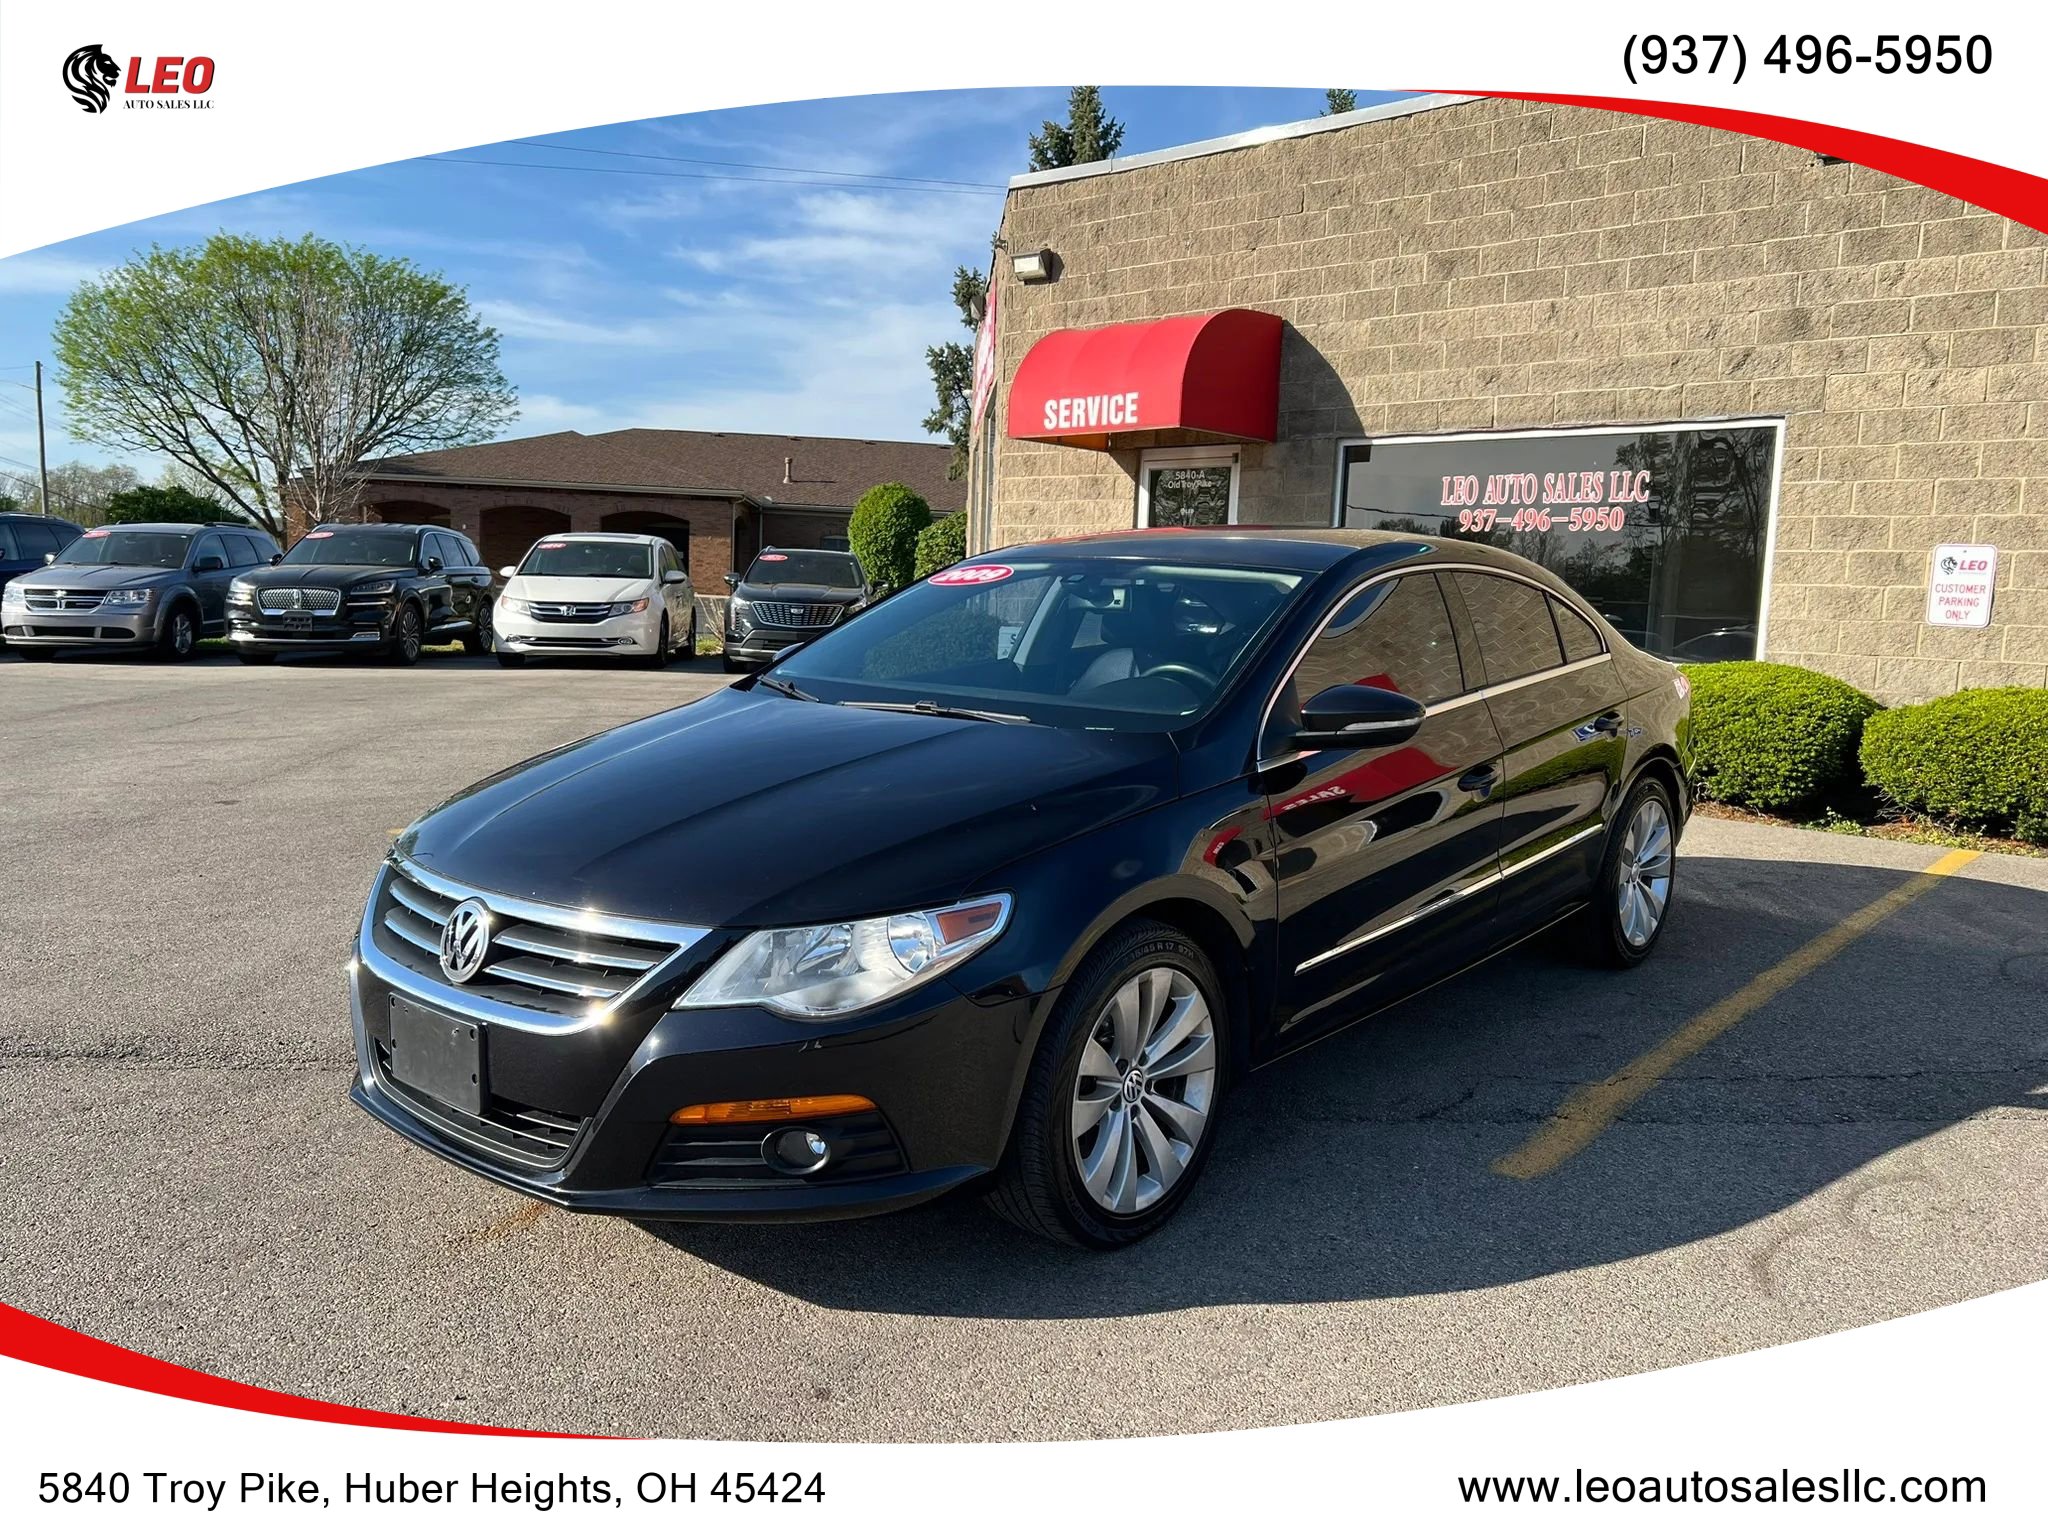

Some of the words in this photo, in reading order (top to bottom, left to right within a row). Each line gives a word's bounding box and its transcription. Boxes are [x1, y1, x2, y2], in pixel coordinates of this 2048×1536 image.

[1043, 391, 1139, 430] SERVICE
[1167, 480, 1180, 489] Old
[1441, 475, 1479, 506] LEO
[1482, 473, 1538, 505] AUTO
[1543, 471, 1604, 504] SALES
[1608, 470, 1650, 503] LLC
[1459, 506, 1625, 532] 937-496-5950
[1958, 559, 1988, 571] LEO
[1935, 583, 1986, 594] CUSTOMER
[1938, 596, 1979, 607] PARKING
[1945, 609, 1970, 620] ONLY
